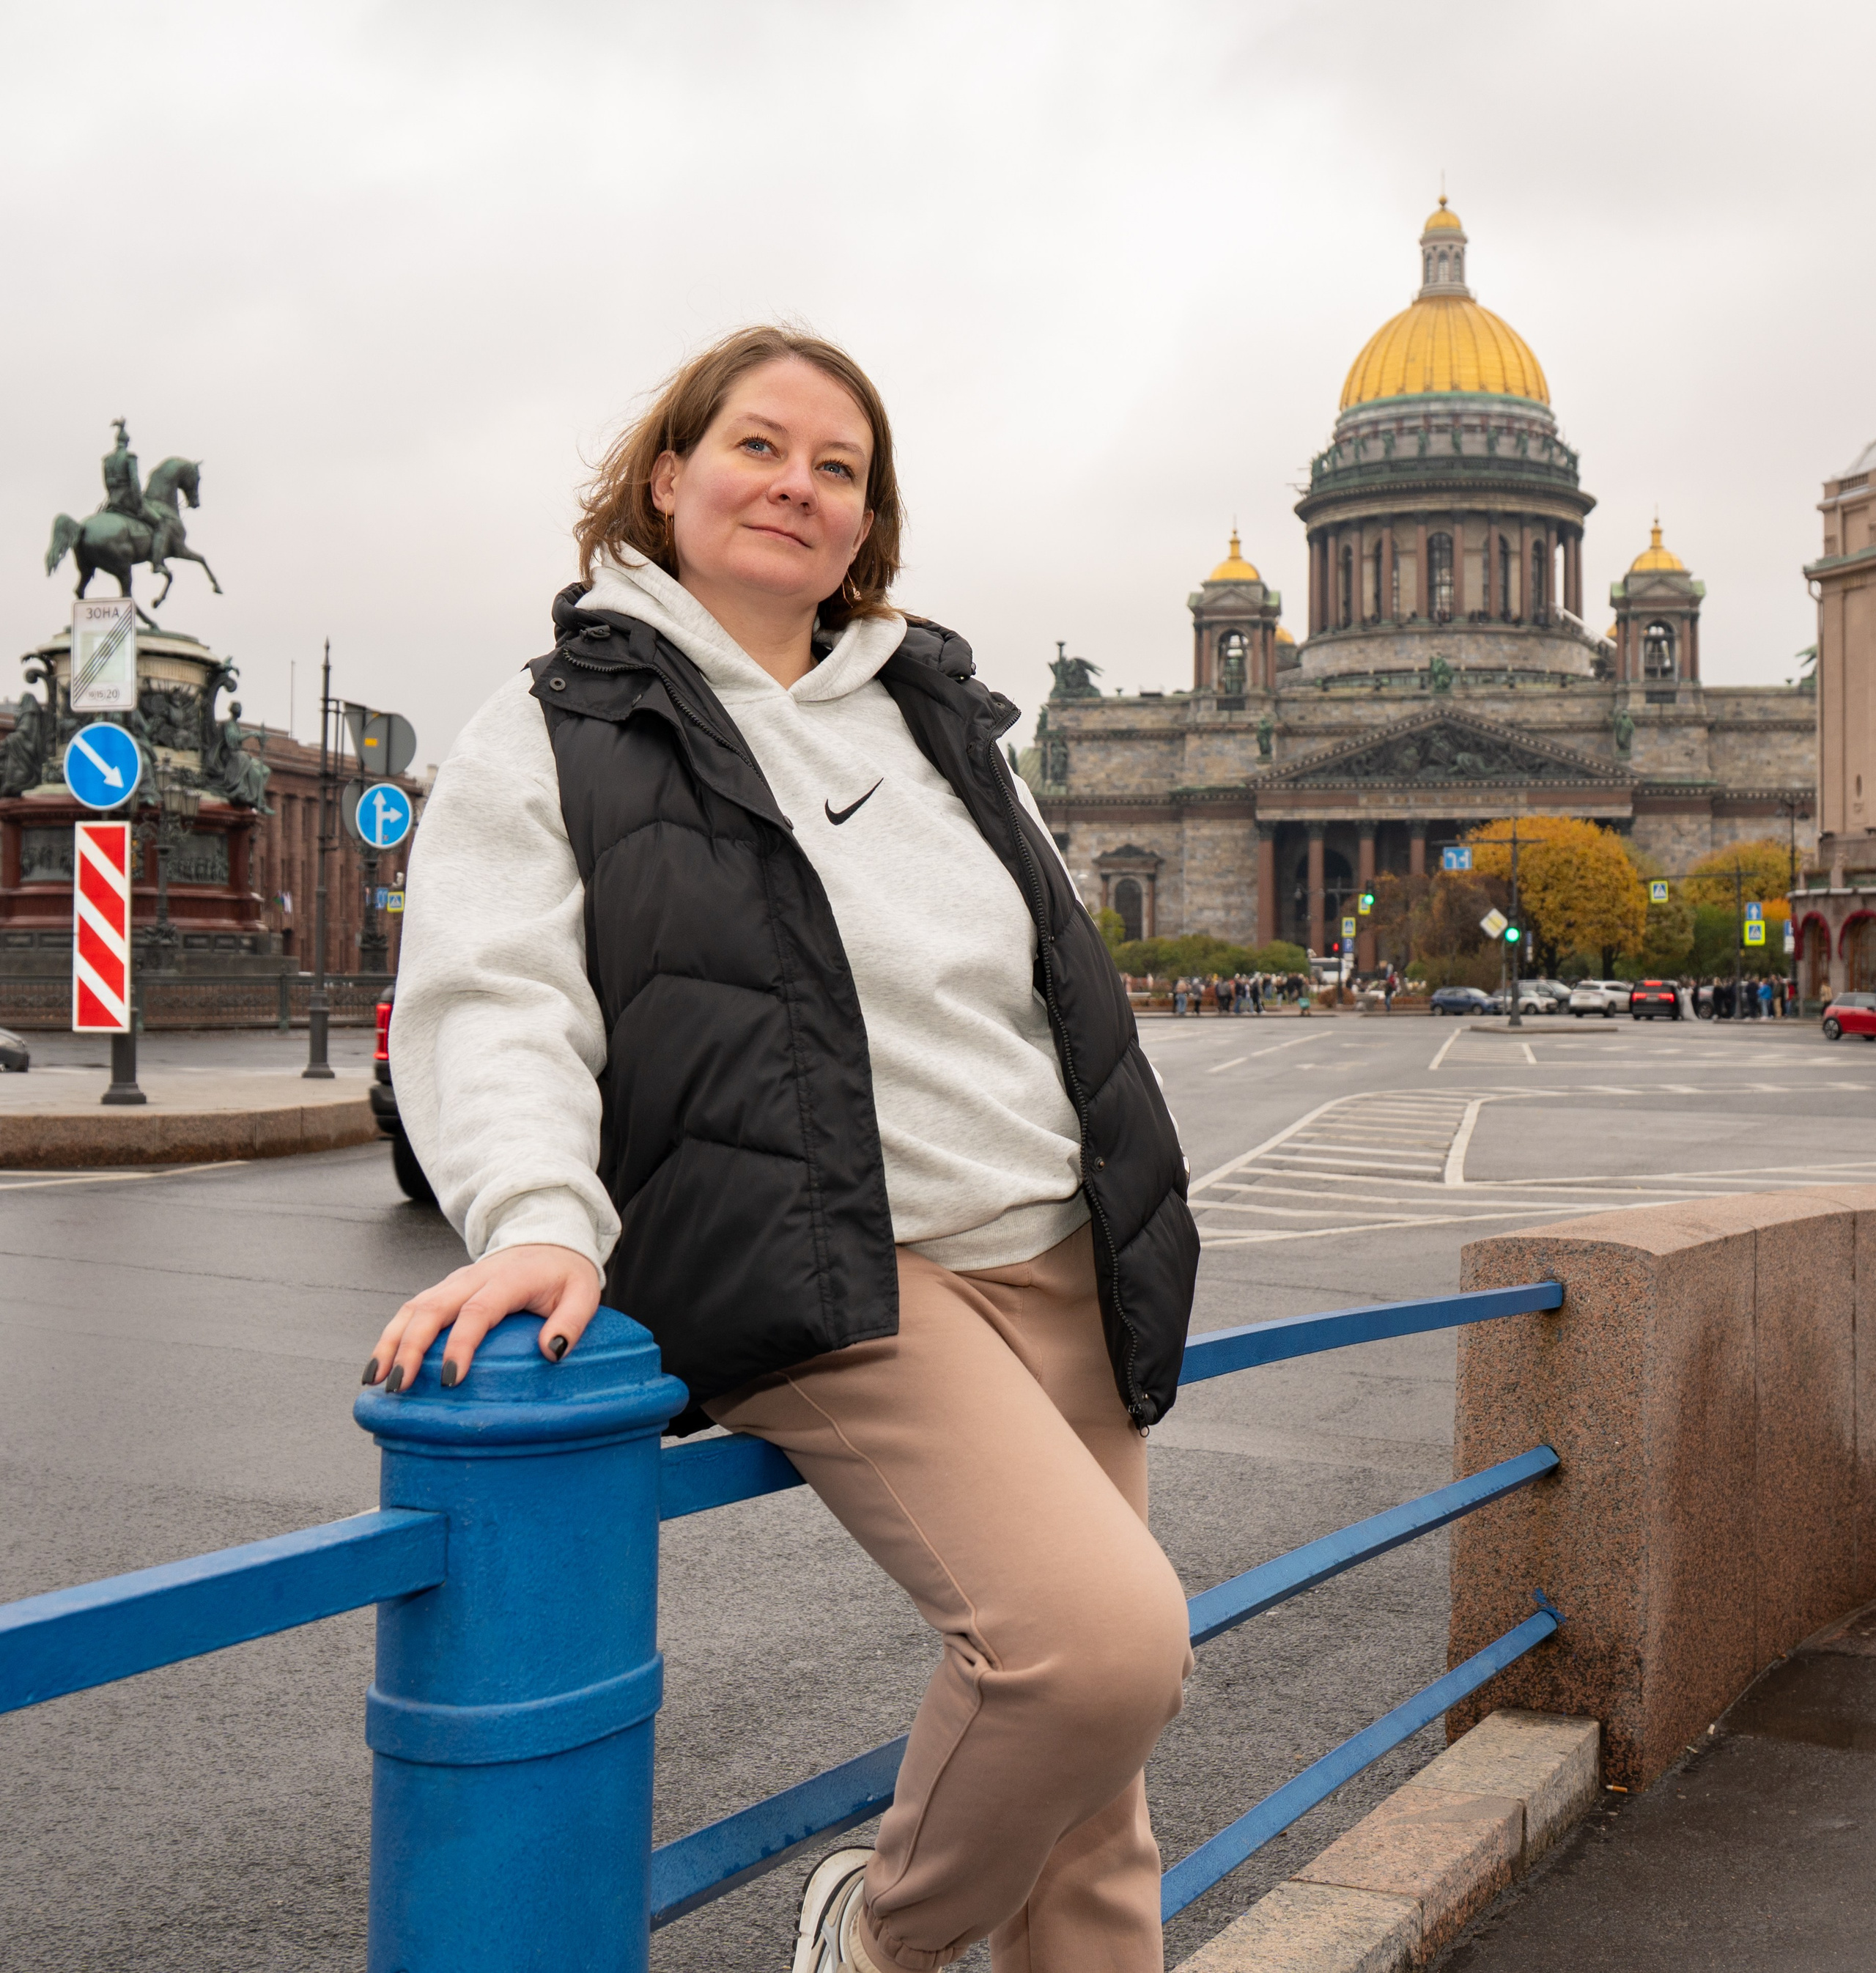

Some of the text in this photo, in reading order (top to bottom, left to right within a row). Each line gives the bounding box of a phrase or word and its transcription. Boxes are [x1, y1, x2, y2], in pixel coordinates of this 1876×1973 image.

[86, 607, 119, 619] ЗОНА
[97, 690, 103, 698] 15
[106, 689, 118, 698] 20
